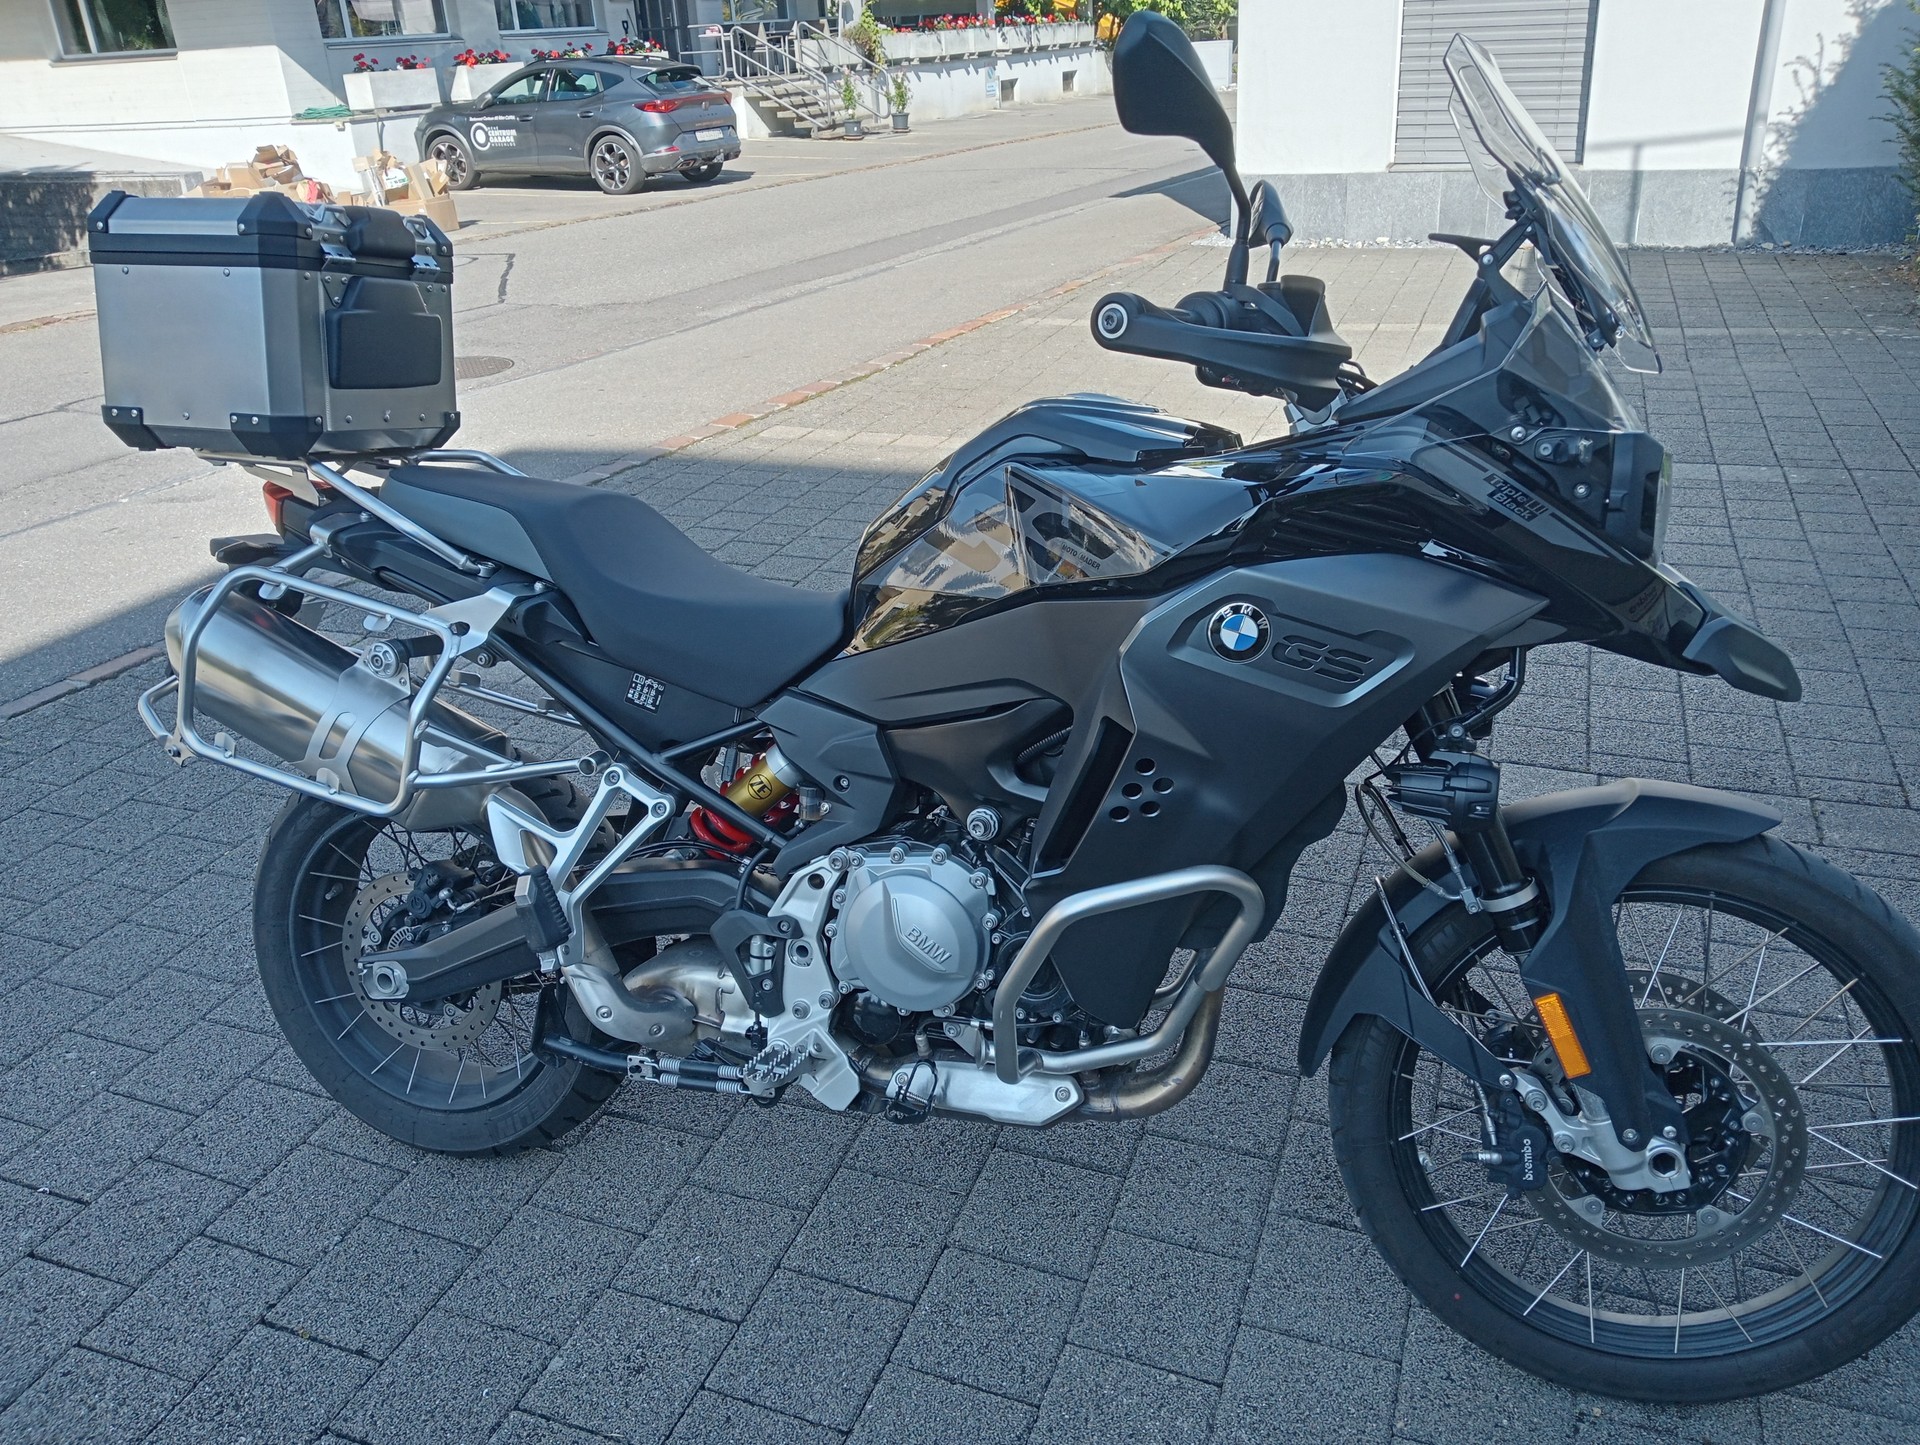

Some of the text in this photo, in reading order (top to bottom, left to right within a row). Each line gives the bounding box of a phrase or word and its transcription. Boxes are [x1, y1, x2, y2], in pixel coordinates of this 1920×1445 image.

[1490, 475, 1527, 503] Triple
[1493, 493, 1532, 519] Black
[1061, 543, 1101, 570] MOTO MADER
[1271, 635, 1374, 684] GS
[749, 774, 773, 800] ZF
[905, 924, 953, 965] BMW
[1521, 1138, 1534, 1181] brembo
